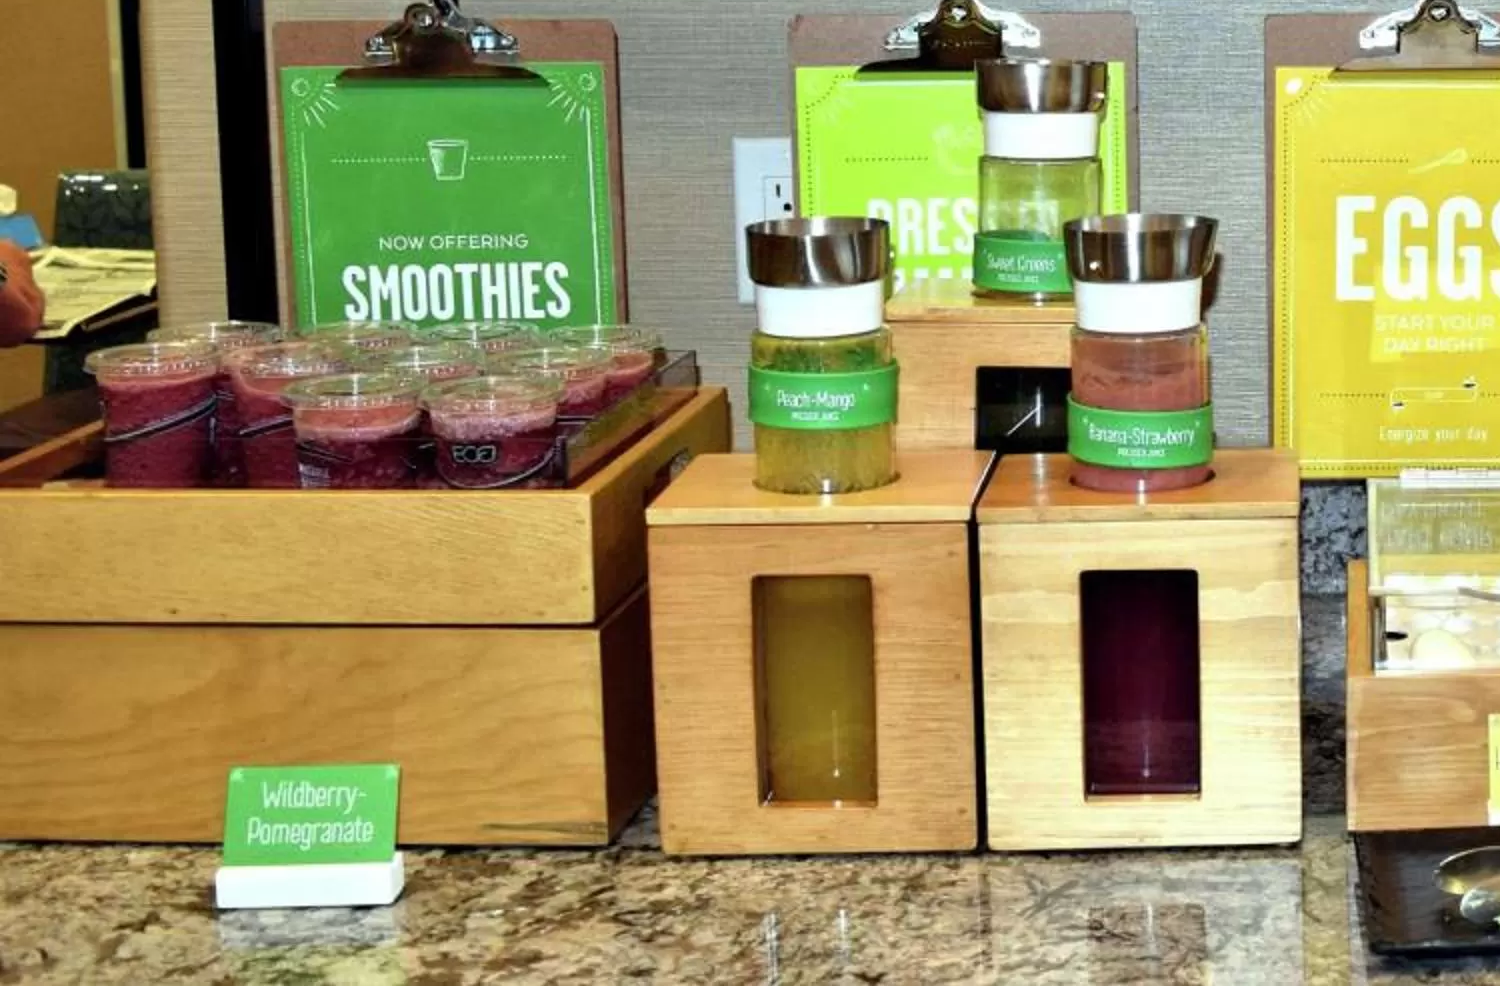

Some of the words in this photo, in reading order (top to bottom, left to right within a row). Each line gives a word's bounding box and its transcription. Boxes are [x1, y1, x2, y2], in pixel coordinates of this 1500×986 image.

[378, 234, 424, 251] NOW
[430, 232, 530, 250] OFFERING
[341, 261, 572, 322] SMOOTHIES
[1375, 314, 1433, 332] START
[1439, 314, 1496, 331] YOUR
[1383, 337, 1421, 354] DAY
[1425, 336, 1488, 353] RIGHT
[777, 389, 857, 412] Peach-Mango
[1088, 422, 1196, 447] Banana-Strawberry
[260, 781, 367, 815] Wildberry-
[246, 816, 375, 851] Pomegranate
